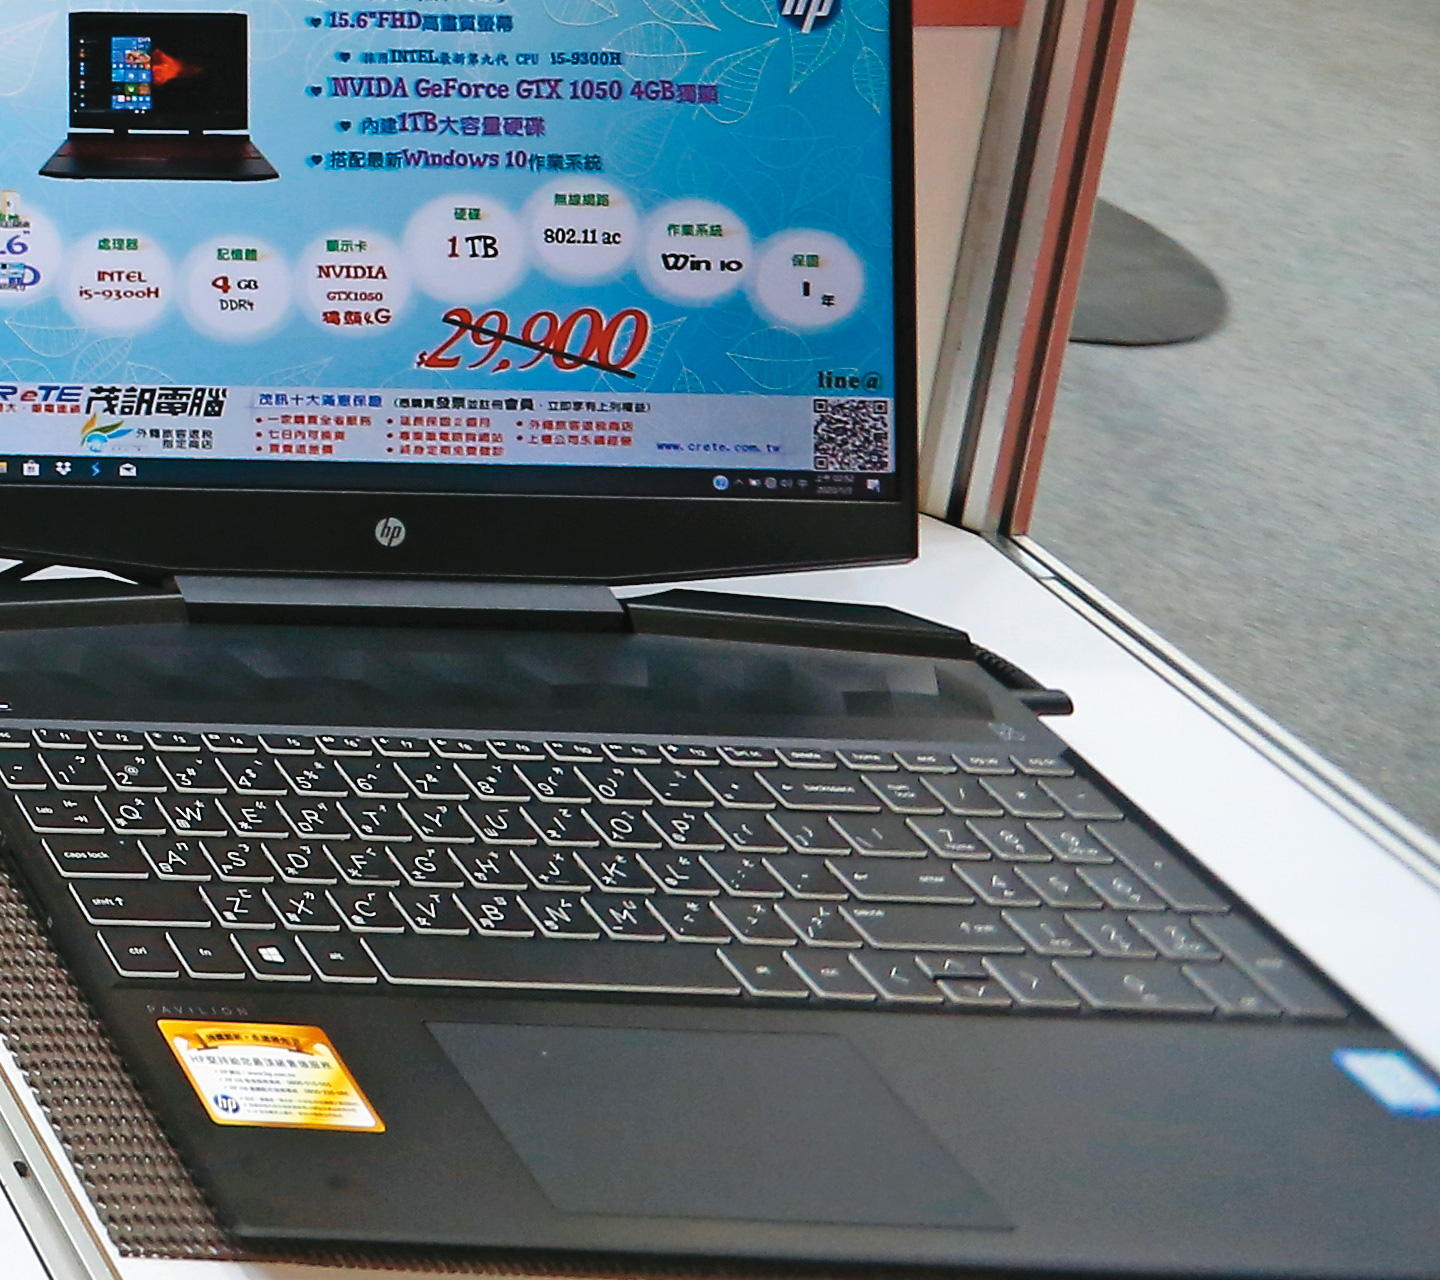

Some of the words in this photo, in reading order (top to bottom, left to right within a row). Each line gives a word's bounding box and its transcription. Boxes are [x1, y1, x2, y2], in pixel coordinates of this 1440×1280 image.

[414, 77, 510, 101] GeForce
[515, 78, 563, 101] GTX
[569, 79, 623, 101] 1050
[447, 237, 459, 258] 1
[465, 234, 499, 259] TB
[543, 227, 598, 246] 802.11
[601, 230, 622, 246] ac
[317, 265, 388, 281] NVIDIA
[661, 253, 712, 272] Win
[84, 386, 229, 418] 茂訊電腦
[374, 516, 407, 547] hp
